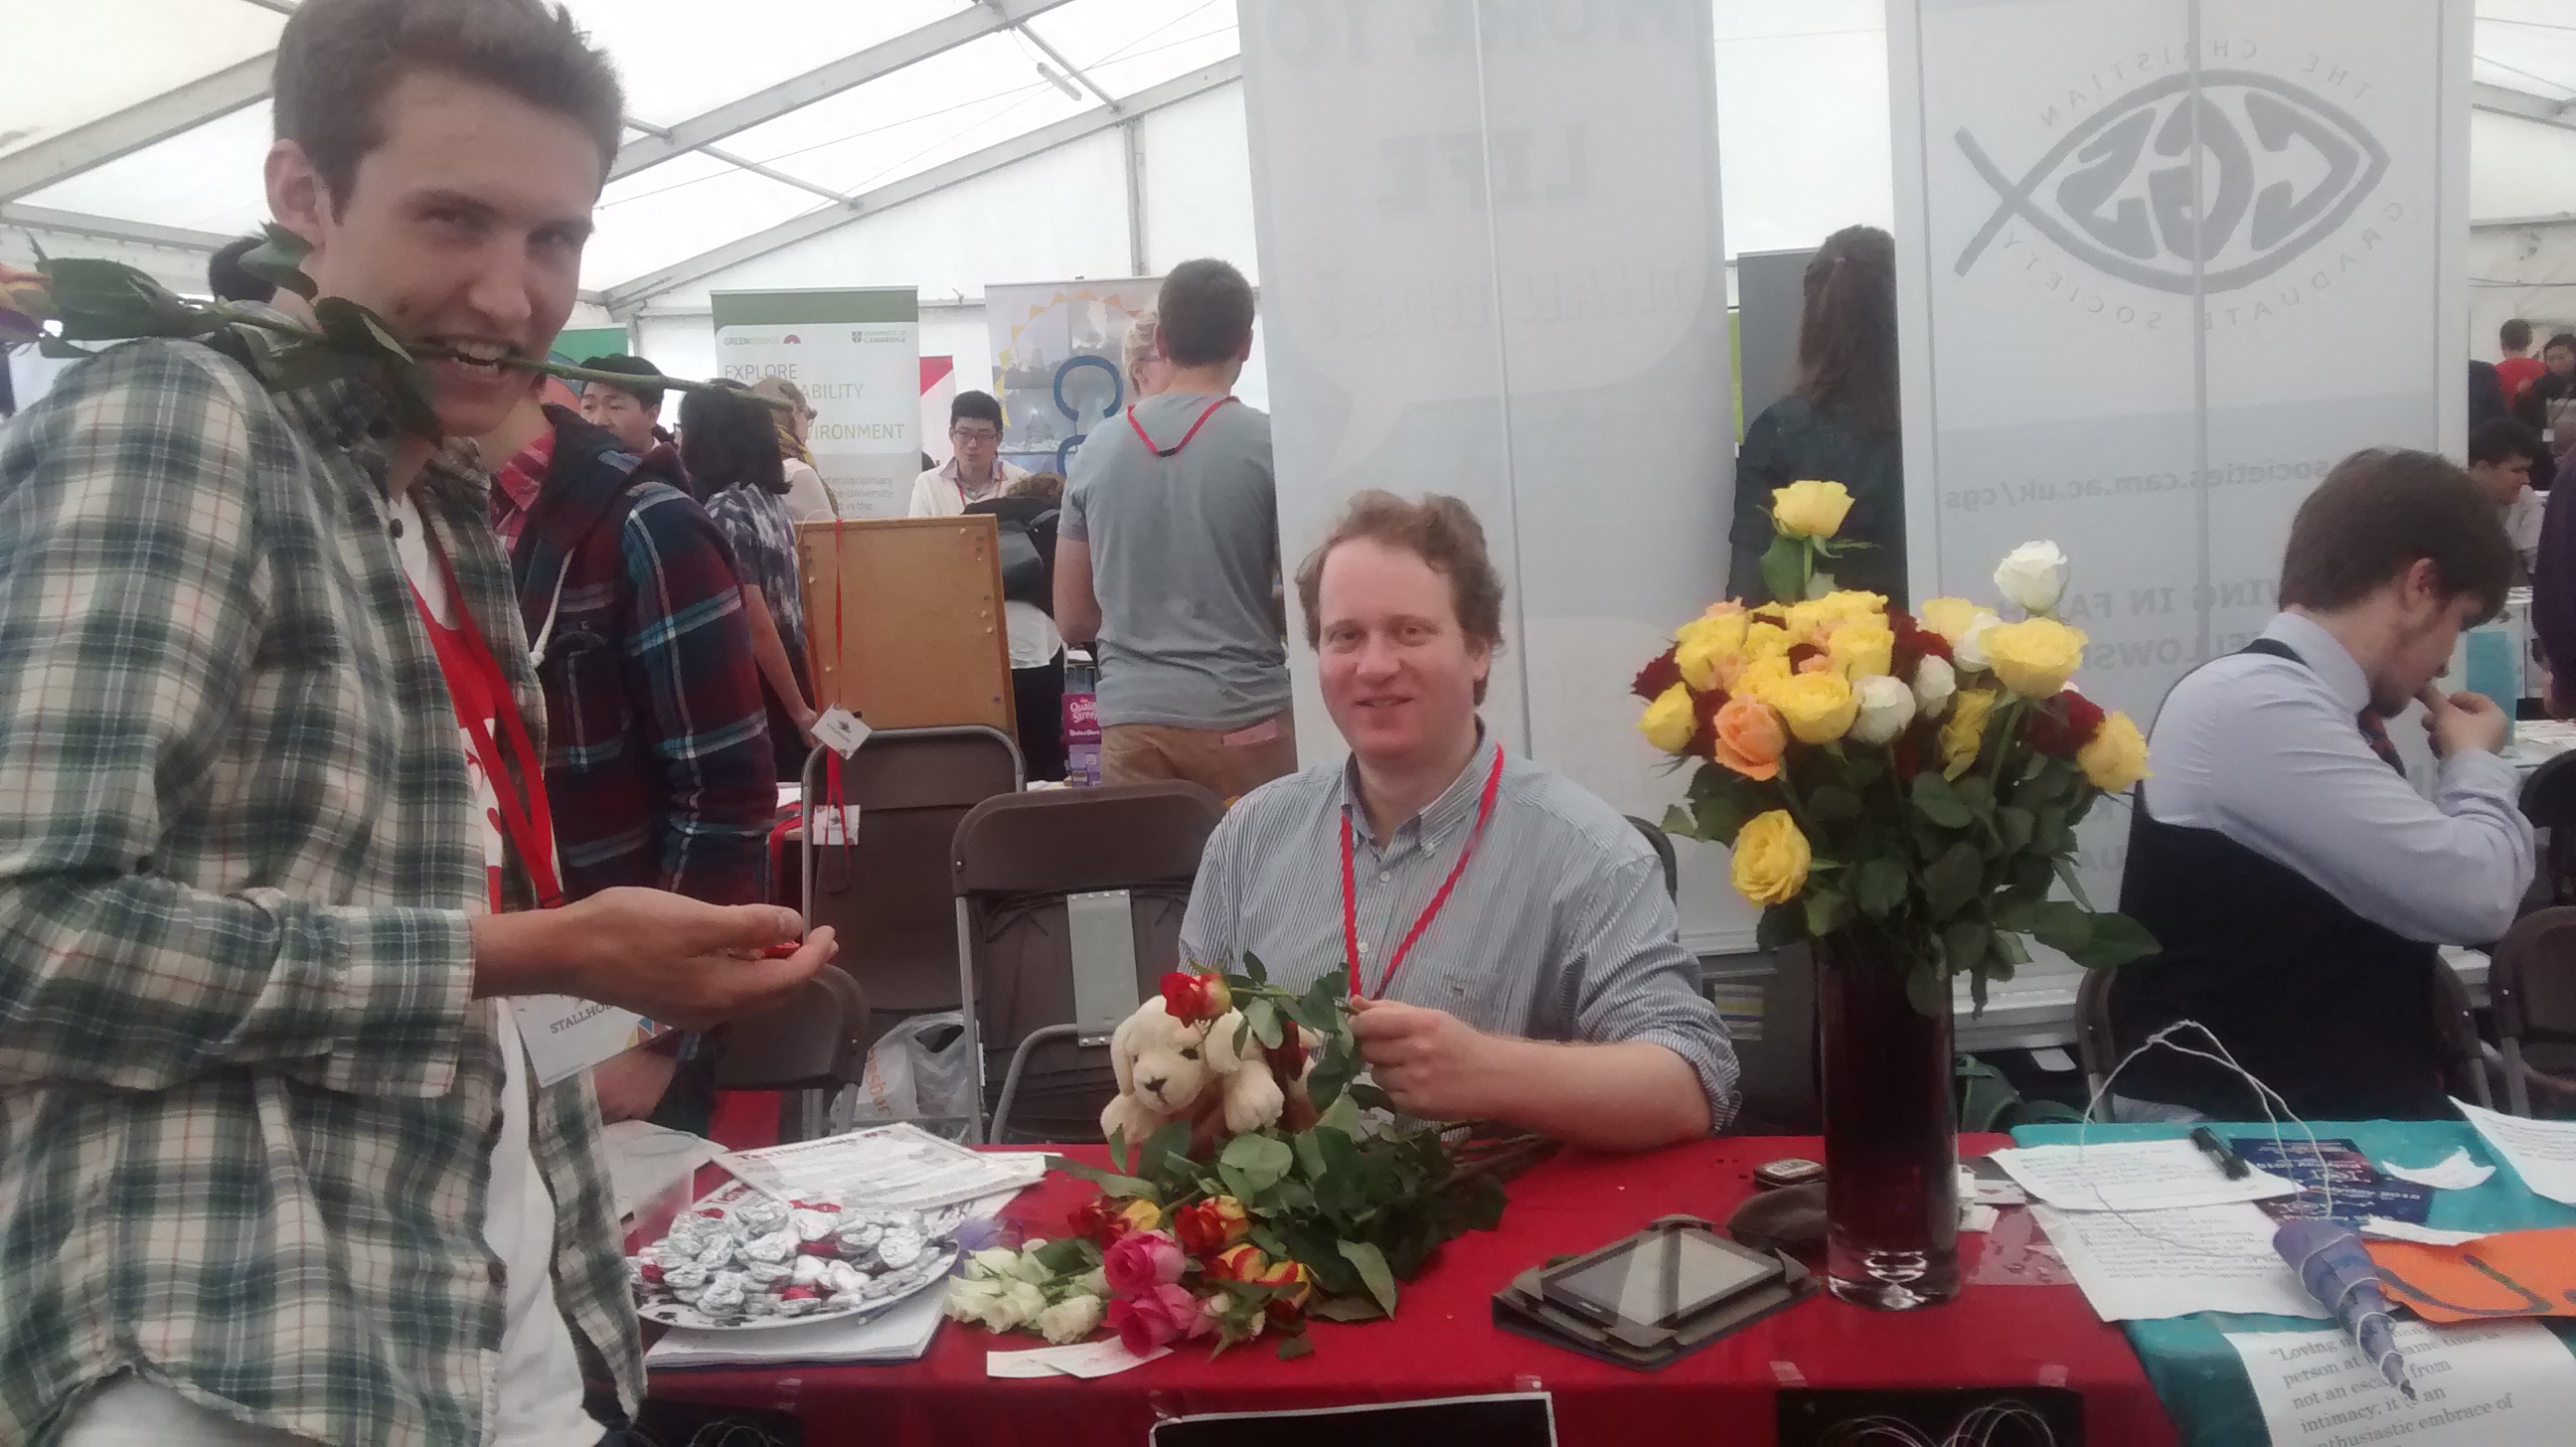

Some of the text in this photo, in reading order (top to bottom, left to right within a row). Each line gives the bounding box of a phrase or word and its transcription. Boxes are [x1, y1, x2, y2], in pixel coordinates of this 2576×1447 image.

[724, 364, 798, 380] EXPLORE
[801, 383, 865, 399] ABILITY
[807, 423, 905, 440] VIRONMENT
[822, 476, 893, 486] nterdisciplinary
[857, 501, 873, 511] the
[2282, 1362, 2340, 1389] person
[2341, 1356, 2362, 1371] at
[2293, 1392, 2322, 1410] not
[2325, 1384, 2347, 1401] an
[2409, 1359, 2453, 1379] from
[2385, 1398, 2400, 1412] it
[2422, 1385, 2448, 1402] an
[2316, 1391, 2514, 1447] nthusiastic embrace of
